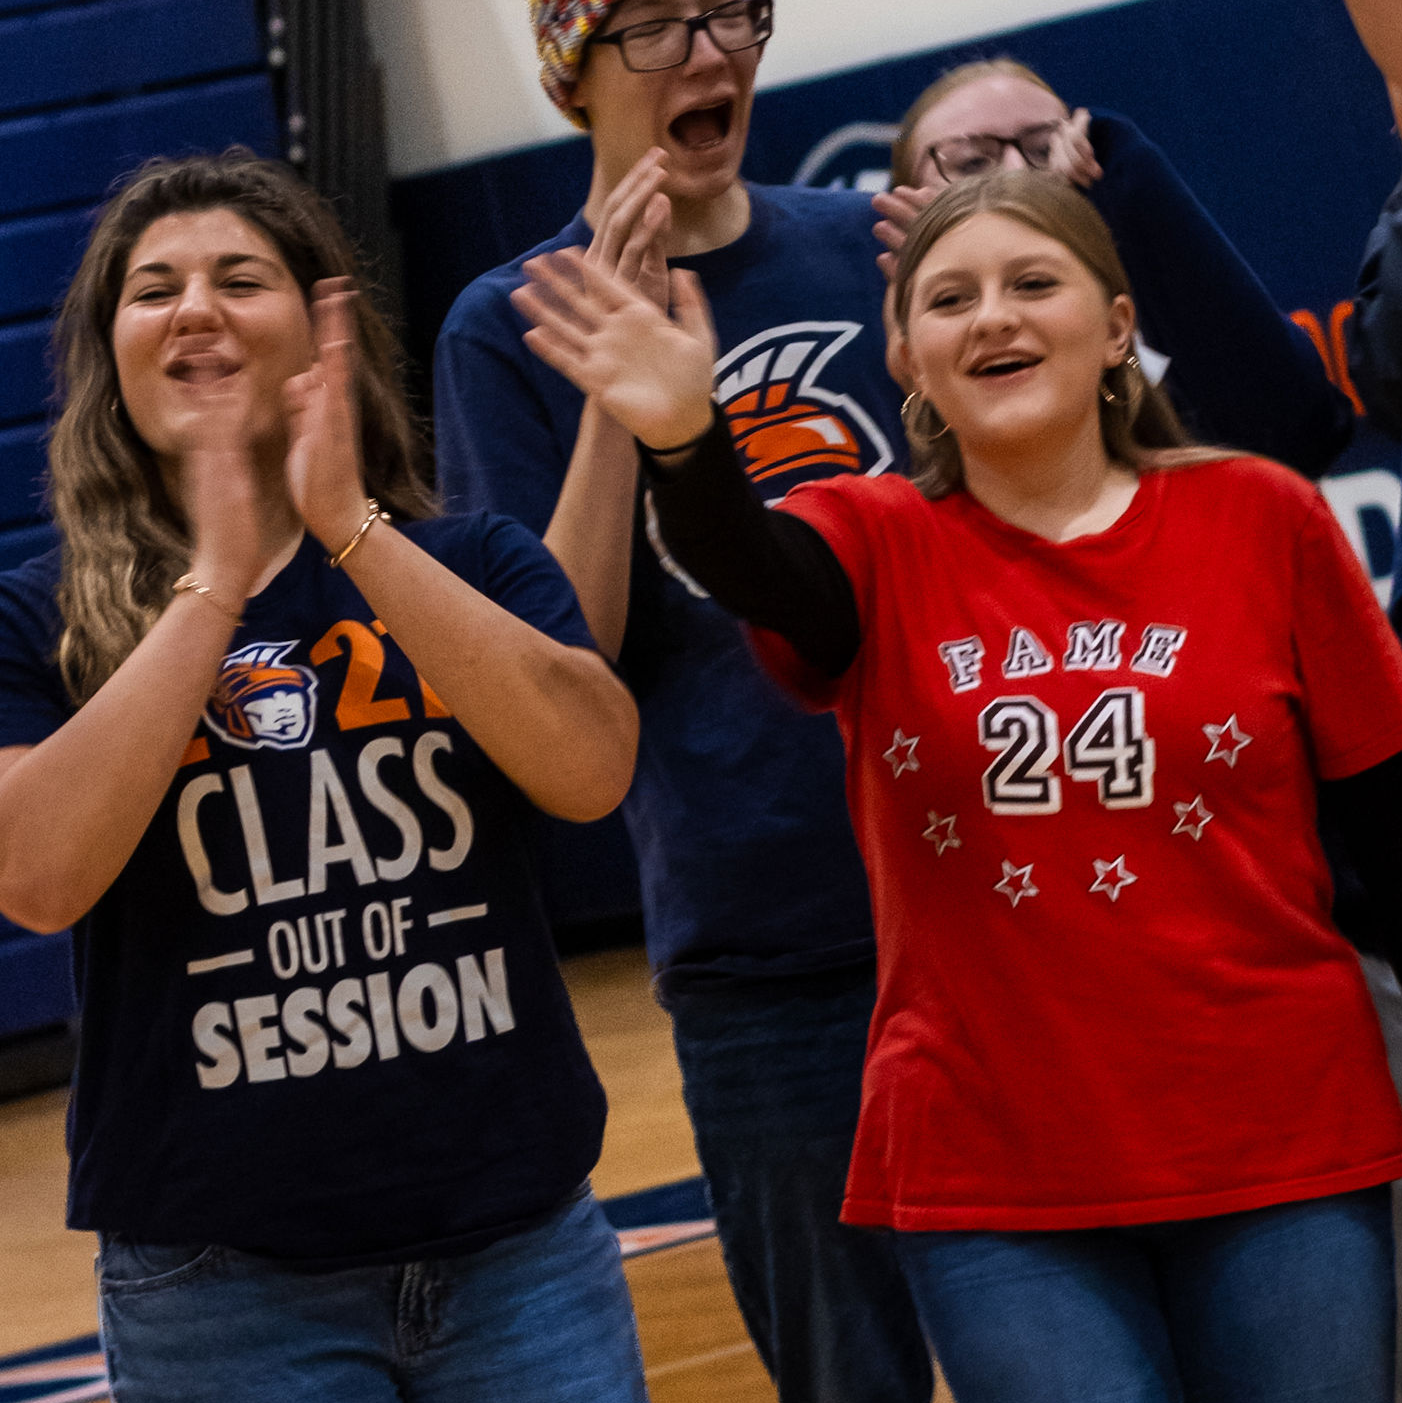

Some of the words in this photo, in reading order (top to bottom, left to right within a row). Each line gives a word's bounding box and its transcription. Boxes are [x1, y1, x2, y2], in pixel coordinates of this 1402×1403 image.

[937, 618, 1188, 695] FAME
[977, 686, 1157, 816] 24
[176, 729, 475, 917] CLASS
[267, 908, 347, 980] OUT
[361, 896, 414, 961] OF
[191, 946, 517, 1090] SESSION
